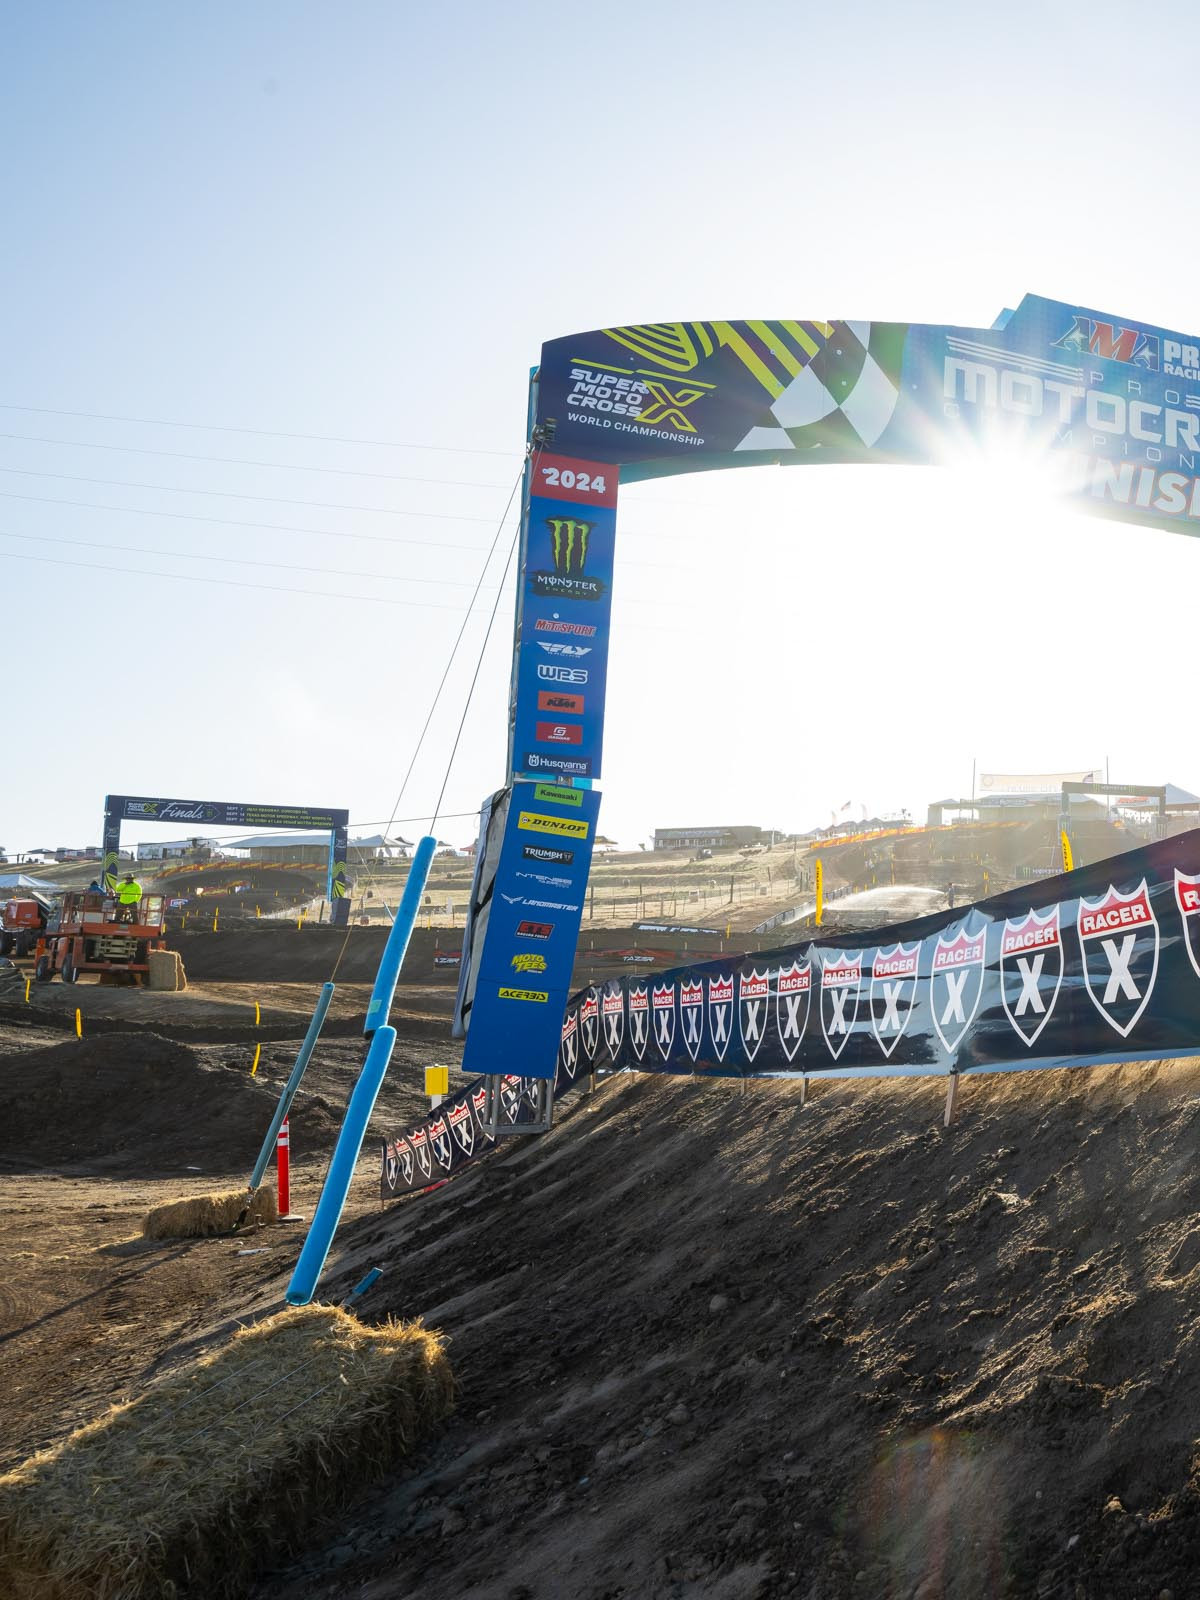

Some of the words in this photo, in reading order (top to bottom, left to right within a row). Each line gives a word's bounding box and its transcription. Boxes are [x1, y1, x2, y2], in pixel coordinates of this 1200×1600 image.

[1050, 316, 1159, 371] AMA
[568, 368, 650, 395] SUPER
[573, 382, 643, 405] MOTO
[567, 394, 643, 417] CROSS
[568, 412, 612, 428] WORLD
[614, 422, 705, 446] CHAMPIONSHIP
[544, 467, 606, 494] 2024
[537, 575, 598, 592] MONSTER
[540, 759, 587, 771] Husqvarna
[540, 790, 578, 801] Kawasaki
[159, 802, 204, 819] Finals
[532, 819, 586, 832] DUNLOP
[524, 848, 563, 860] TRIUMPH
[1082, 904, 1147, 932] RACER
[1005, 927, 1056, 951] RACER
[512, 954, 545, 966] MOTO
[875, 958, 915, 976] RACER
[936, 945, 982, 966] RACER
[823, 968, 859, 984] RACER
[1101, 934, 1142, 1004] X
[711, 988, 732, 1000] RACER
[742, 984, 767, 995] RACER
[781, 976, 809, 991] RACER
[1014, 954, 1045, 1016] X
[604, 1001, 622, 1011] RACER
[630, 998, 648, 1007] RACER
[654, 994, 673, 1005] RACER
[682, 991, 701, 1002] RACER
[879, 981, 904, 1031] X
[940, 969, 970, 1025] X
[715, 1004, 727, 1042] X
[745, 1000, 760, 1041] X
[783, 995, 802, 1039] X
[828, 989, 848, 1036] X
[609, 1014, 619, 1045] X
[634, 1011, 644, 1043] X
[659, 1009, 670, 1043] X
[687, 1007, 698, 1043] X
[450, 1109, 469, 1123] RACER
[457, 1120, 472, 1147] X
[419, 1146, 430, 1169] X
[435, 1133, 450, 1162] X
